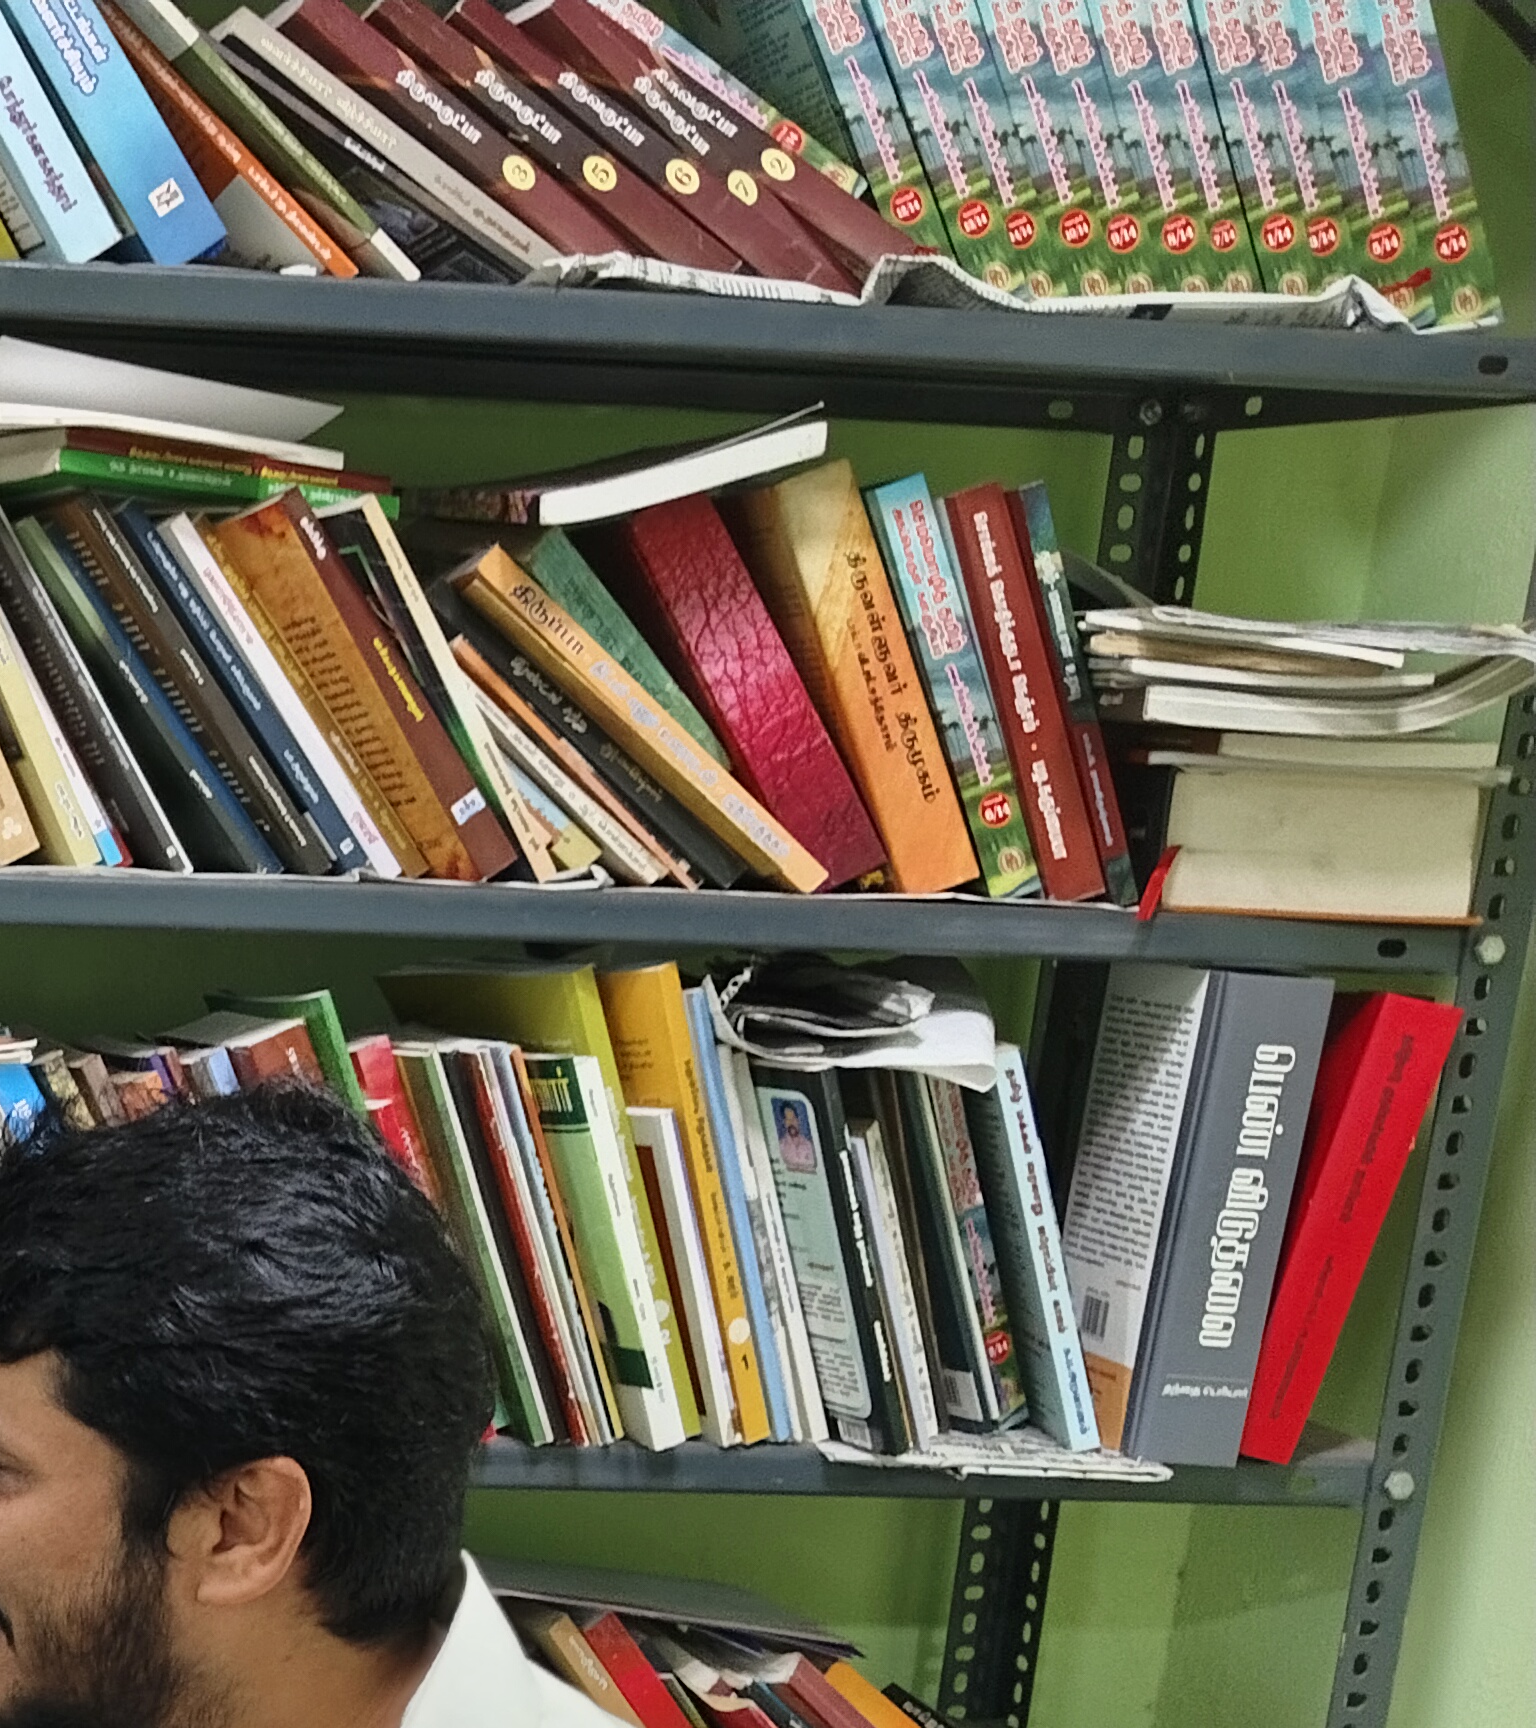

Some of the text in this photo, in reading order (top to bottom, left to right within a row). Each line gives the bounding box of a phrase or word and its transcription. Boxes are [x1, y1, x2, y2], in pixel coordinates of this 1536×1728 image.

[396, 69, 482, 145] திருவருட்பா
[475, 69, 561, 145] திருவருட்பா
[558, 71, 645, 147] திருவருட்பா
[836, 547, 918, 698] திருவள்ளுவர்
[889, 706, 948, 805] திருமுகம்
[1188, 1038, 1301, 1352] பெண் விடுதலை
